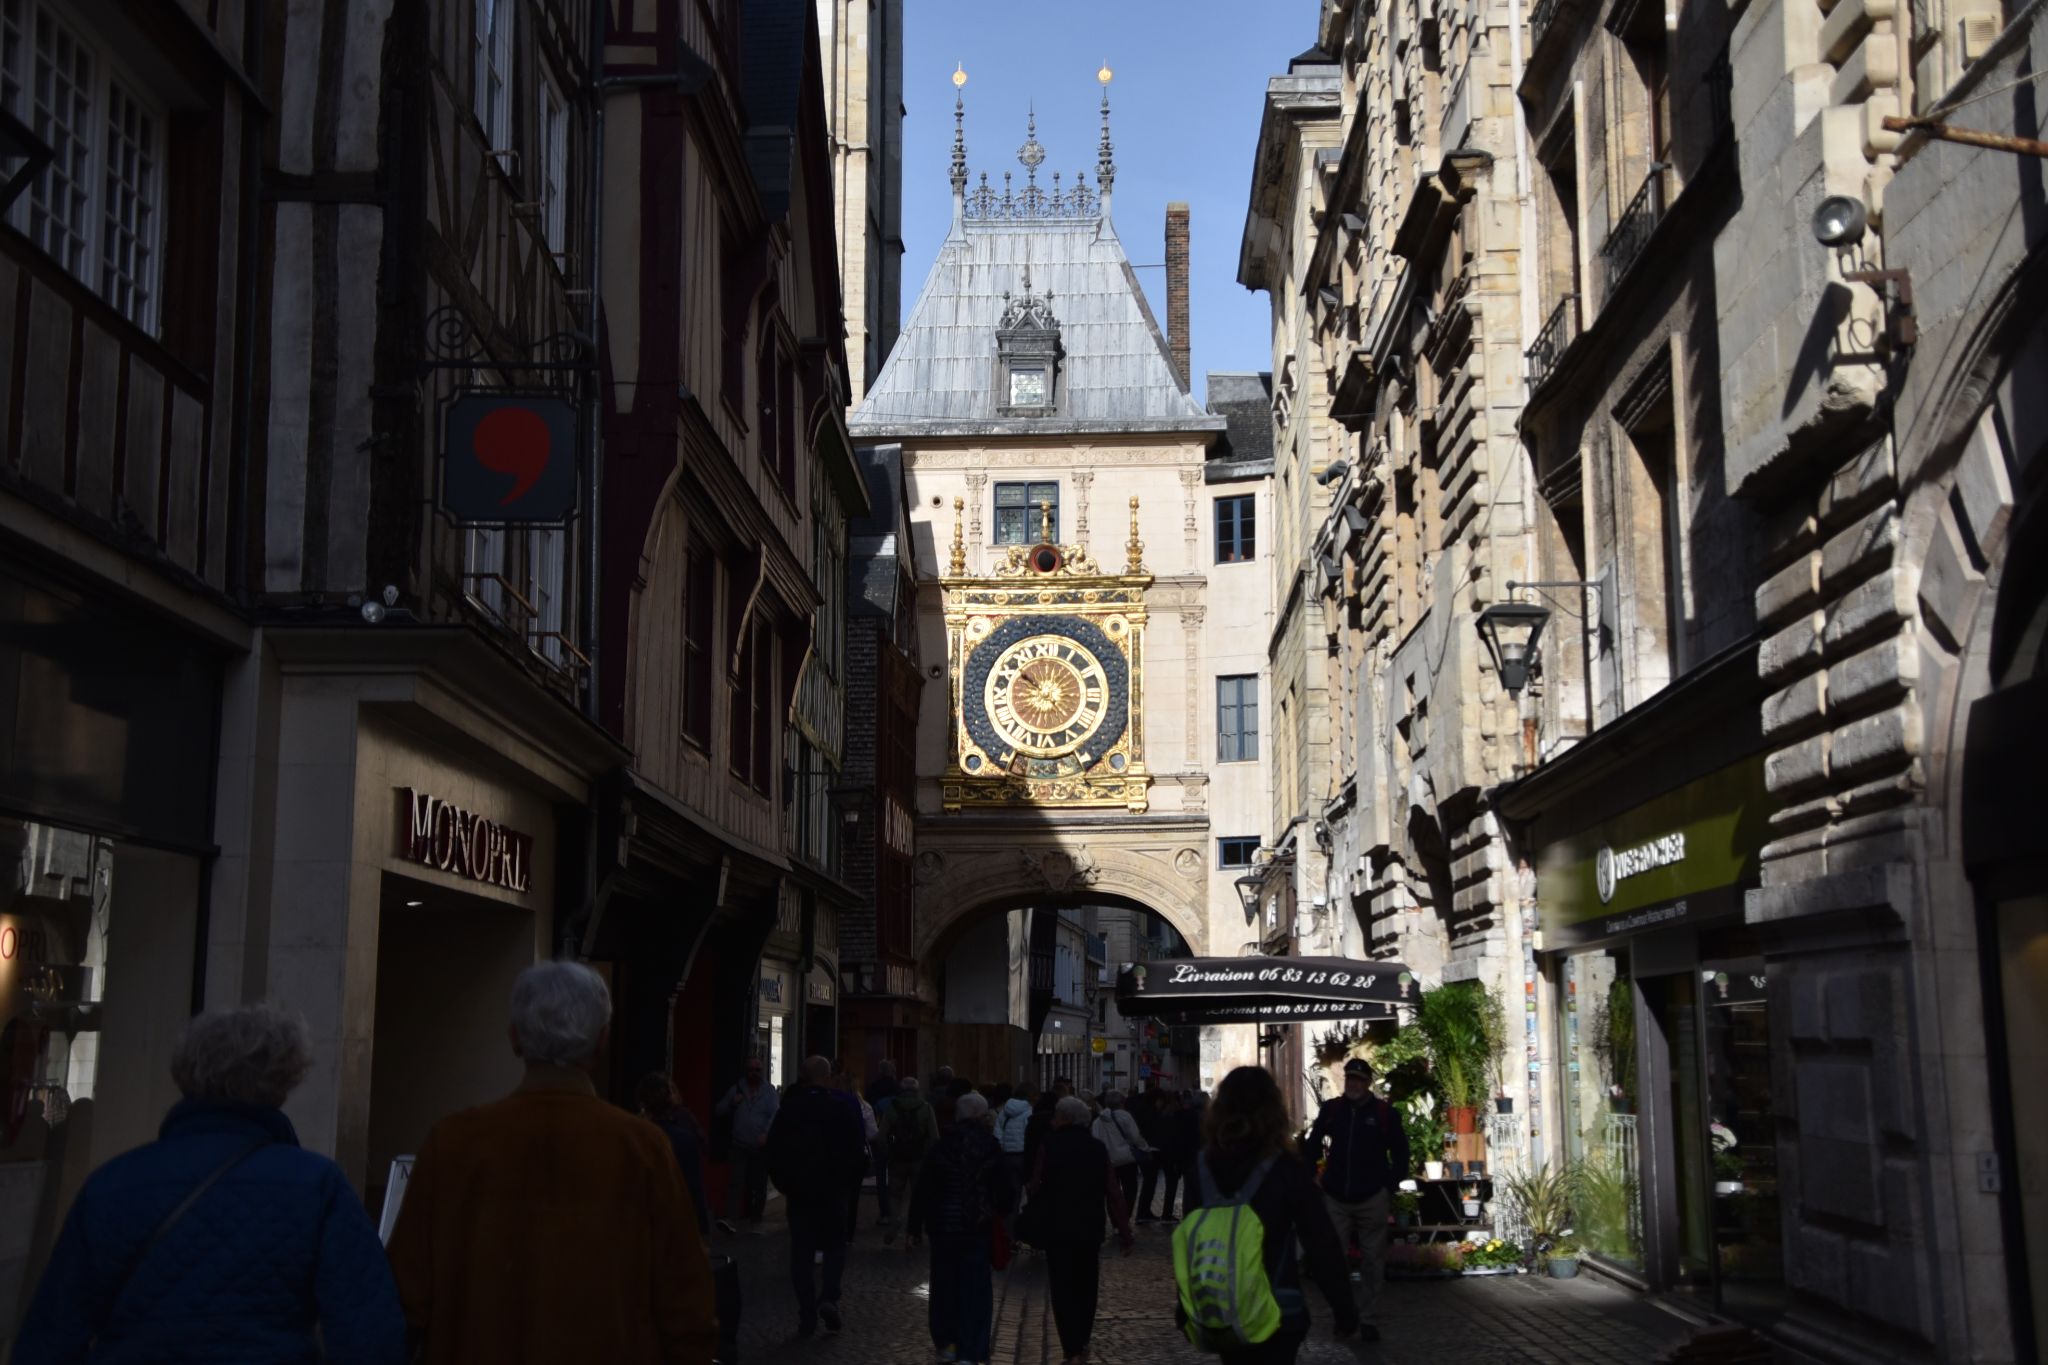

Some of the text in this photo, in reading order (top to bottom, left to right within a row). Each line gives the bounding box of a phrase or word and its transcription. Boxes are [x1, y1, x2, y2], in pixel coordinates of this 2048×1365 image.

[1035, 643, 1059, 657] XII
[1086, 687, 1101, 703] III
[1169, 964, 1376, 989] Livraison 06 83 13 62 28
